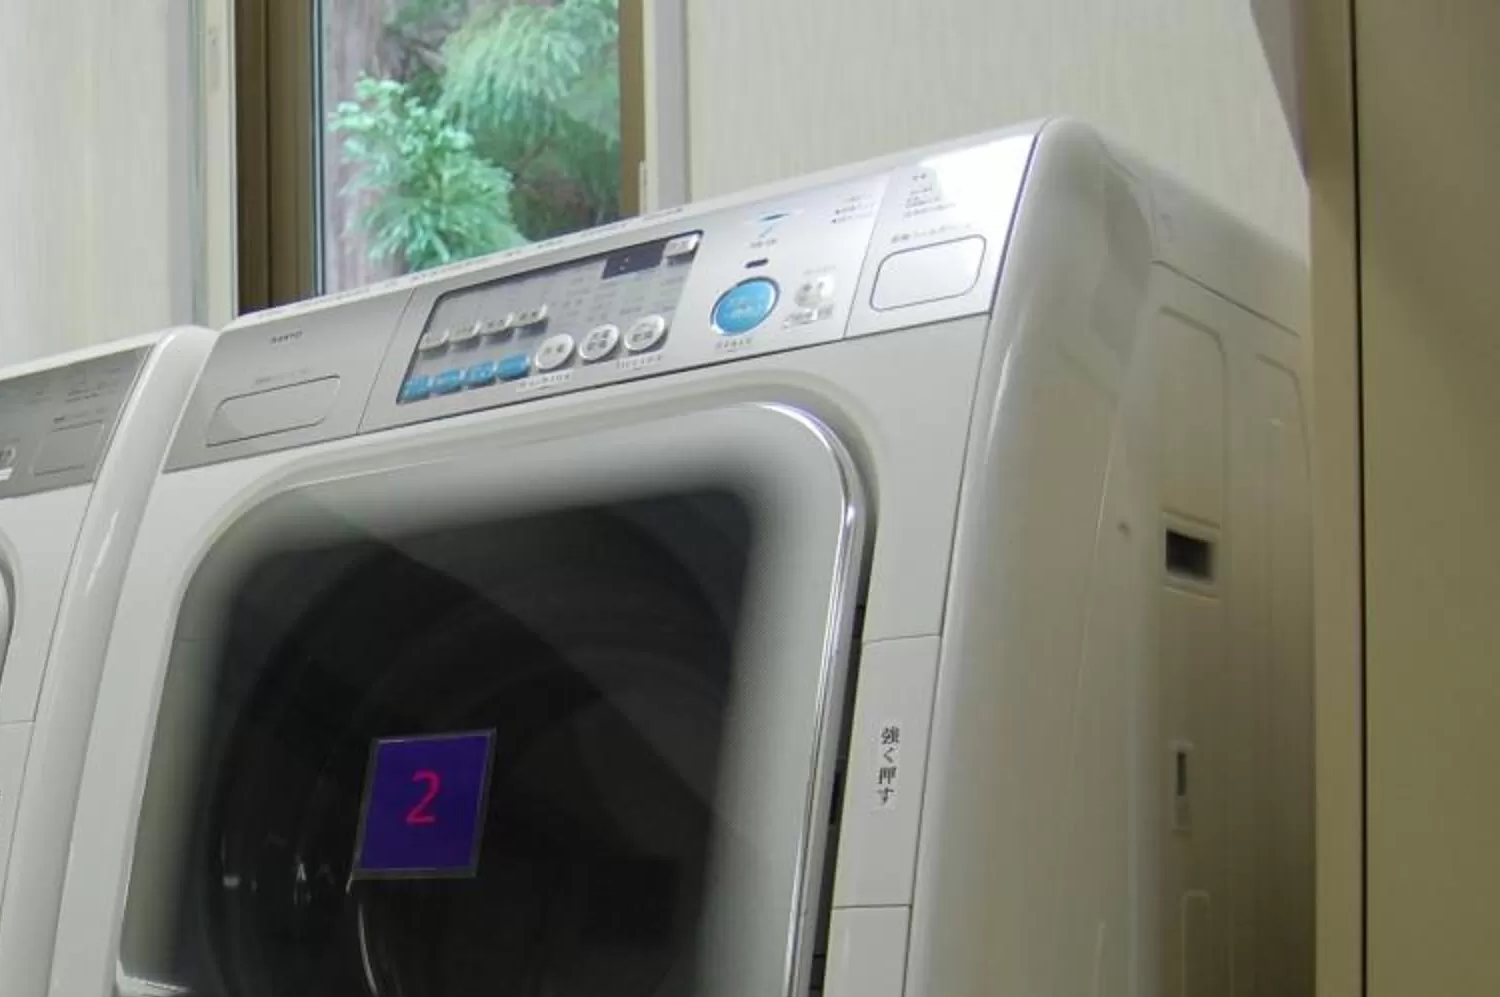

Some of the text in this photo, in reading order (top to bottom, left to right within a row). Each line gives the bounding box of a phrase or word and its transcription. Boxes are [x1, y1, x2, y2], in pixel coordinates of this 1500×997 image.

[405, 767, 442, 826] 2
[876, 725, 901, 806] 強く押す
